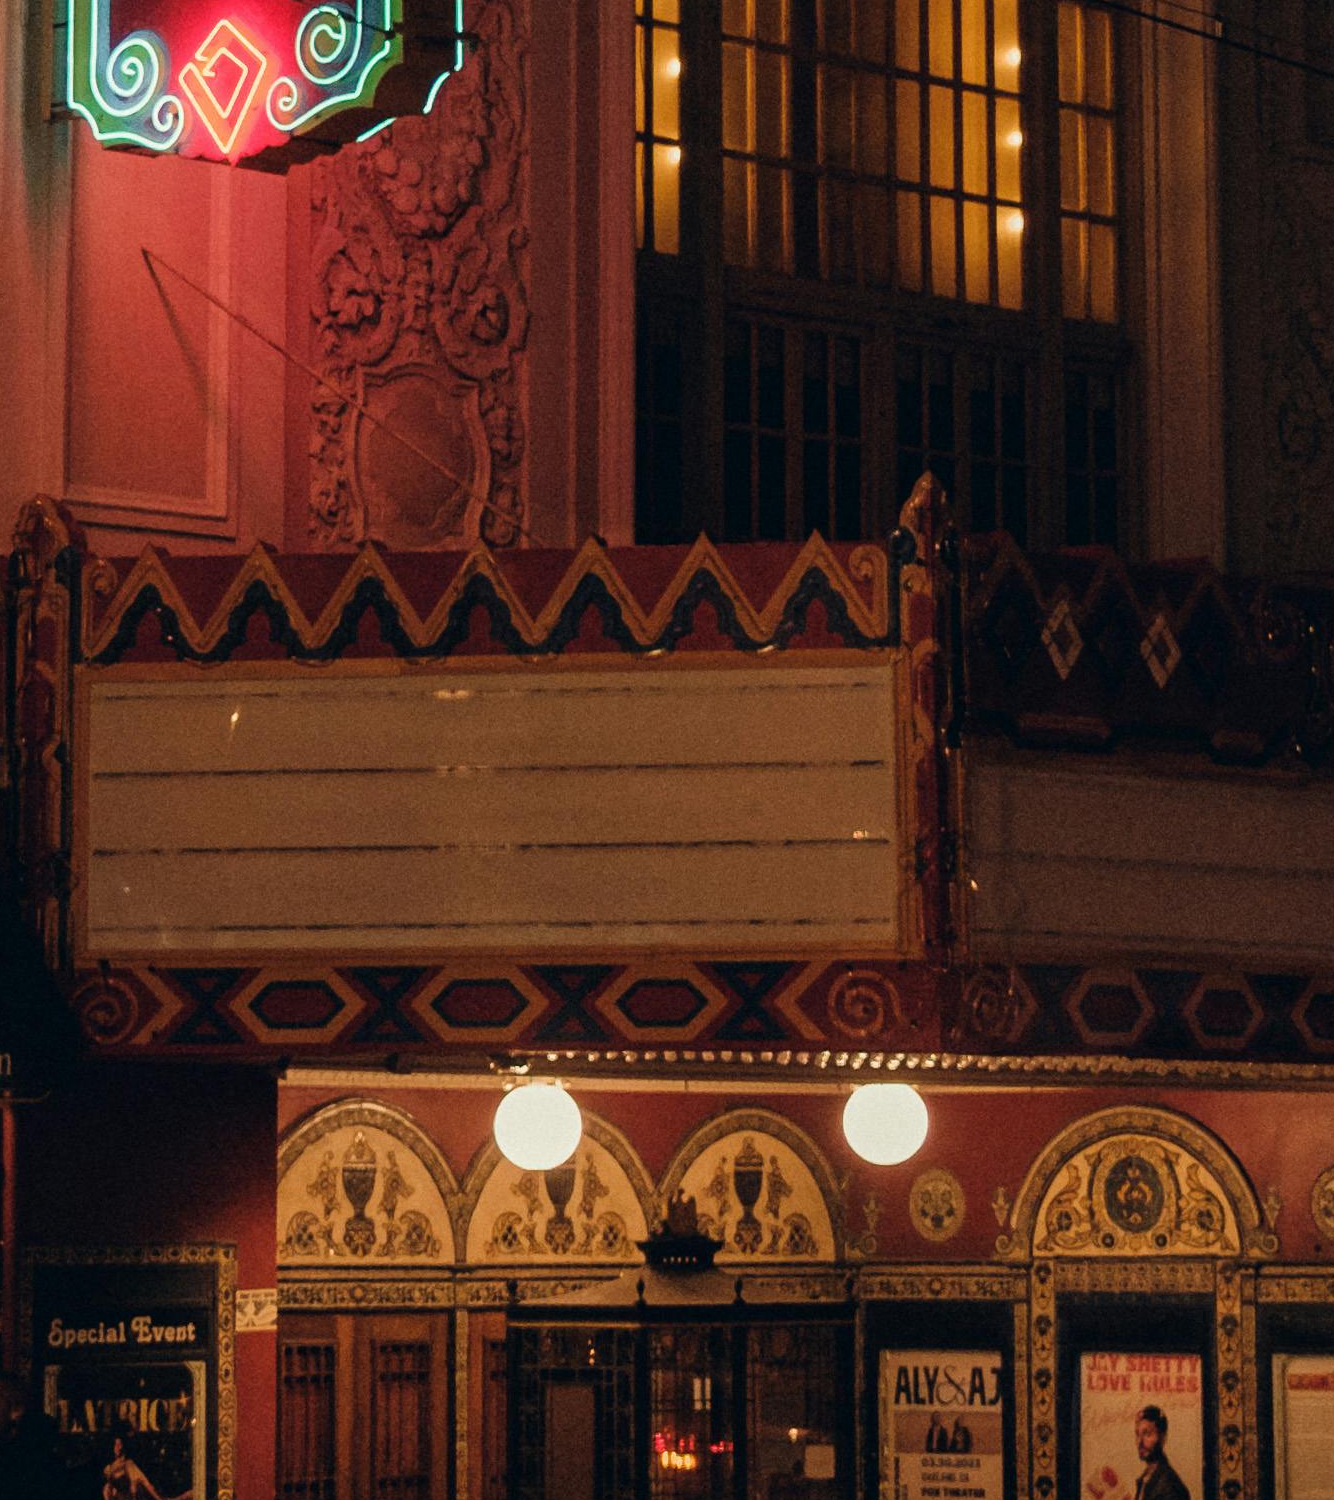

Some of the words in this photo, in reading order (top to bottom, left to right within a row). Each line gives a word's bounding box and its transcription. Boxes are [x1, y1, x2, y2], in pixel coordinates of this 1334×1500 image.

[47, 1317, 127, 1348] Special
[130, 1314, 197, 1344] Event
[1125, 1354, 1199, 1373] SHETTY
[1087, 1374, 1131, 1391] LOVE
